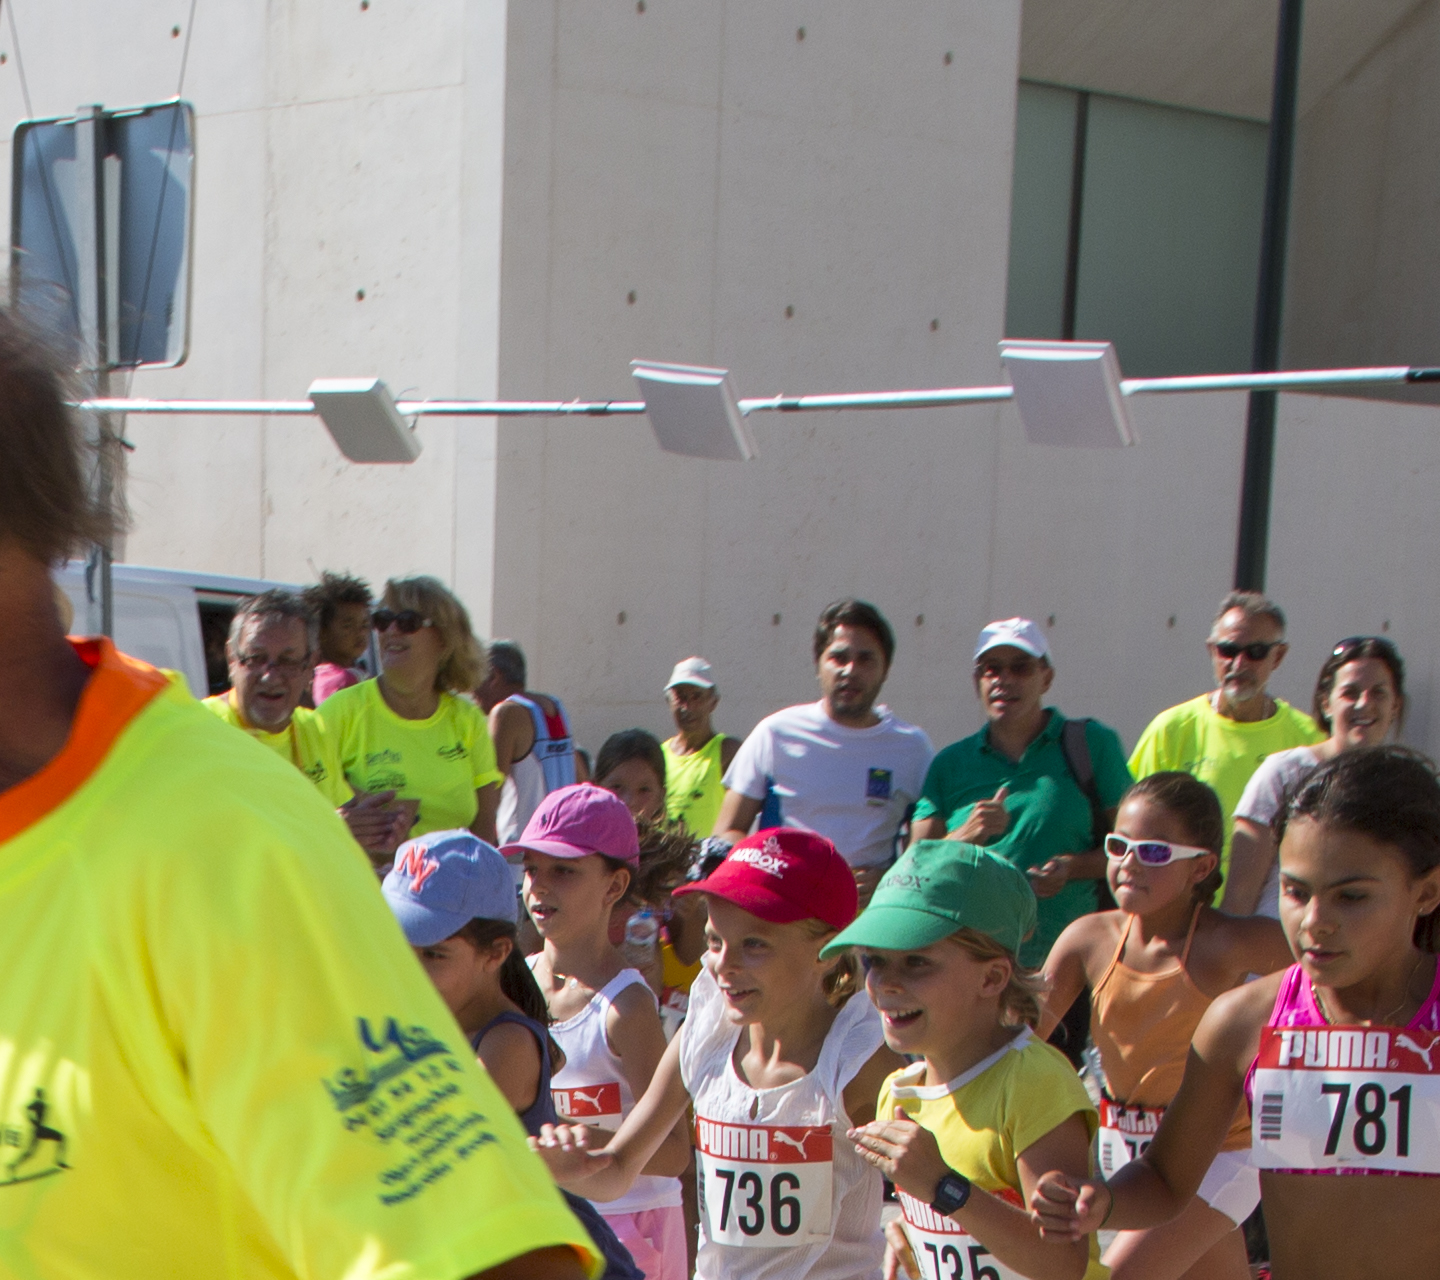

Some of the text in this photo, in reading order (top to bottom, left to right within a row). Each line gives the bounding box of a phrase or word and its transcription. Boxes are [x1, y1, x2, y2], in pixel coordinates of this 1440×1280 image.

[397, 844, 440, 893] NY
[1278, 1030, 1390, 1069] PUMA
[699, 1123, 769, 1161] PUMA
[1321, 1082, 1413, 1157] 781
[715, 1168, 801, 1236] 736
